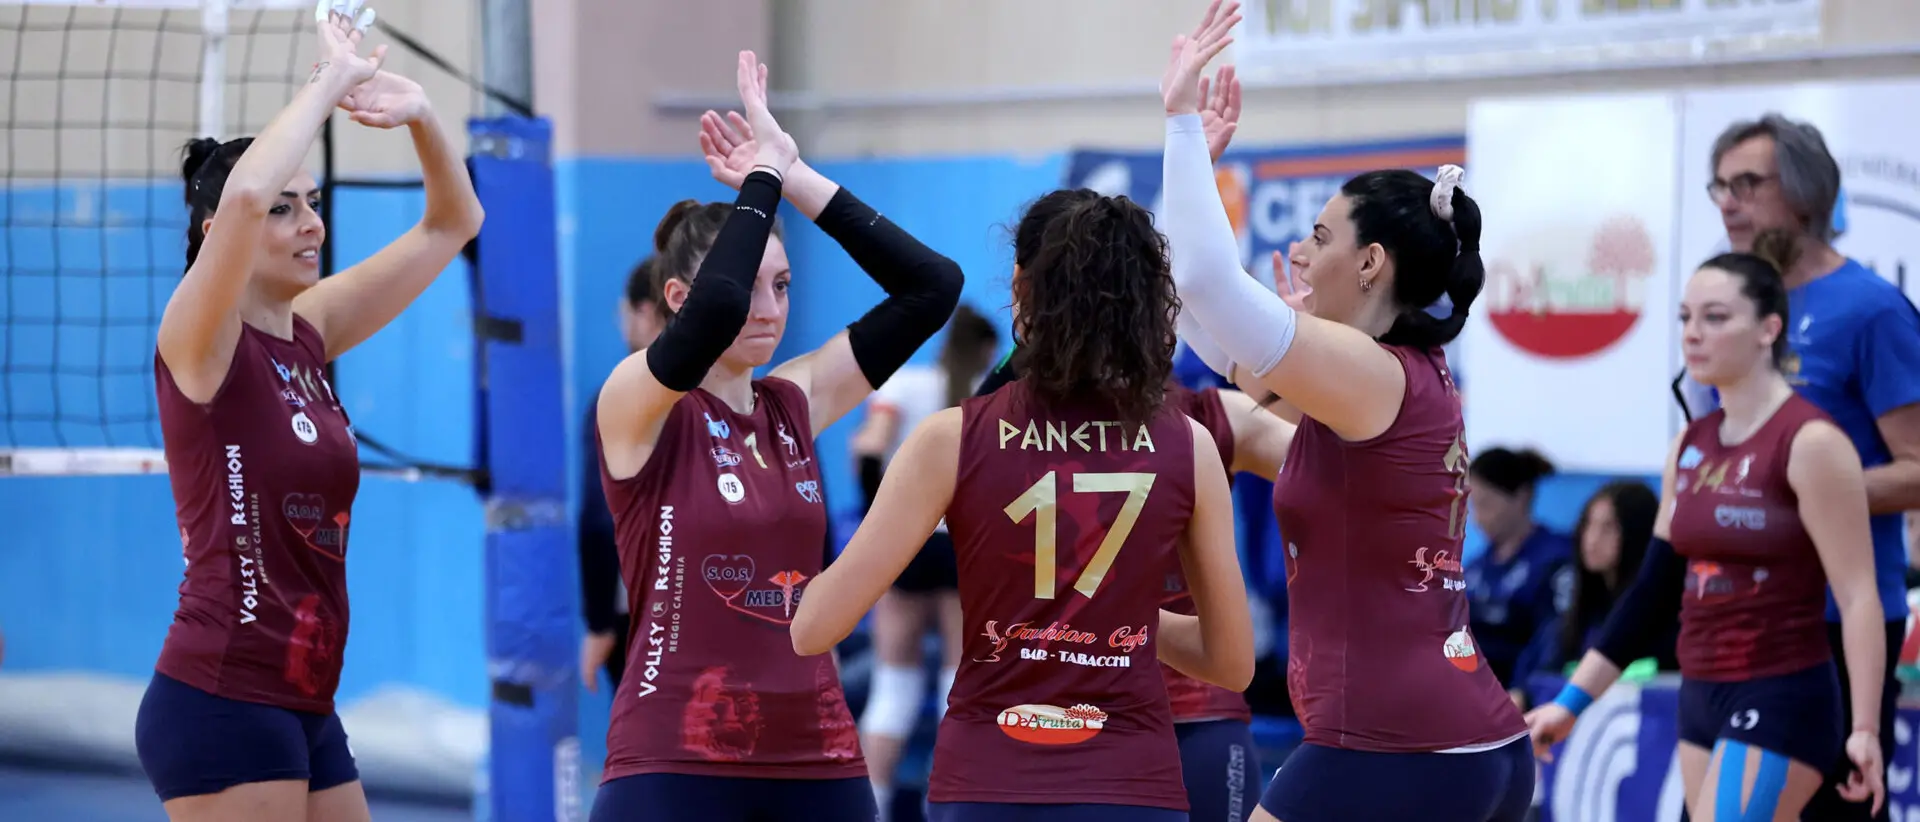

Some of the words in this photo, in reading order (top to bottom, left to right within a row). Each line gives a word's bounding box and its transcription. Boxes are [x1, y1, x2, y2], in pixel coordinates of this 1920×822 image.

[999, 418, 1156, 453] PANETTA
[225, 444, 248, 526] REGHION
[1003, 471, 1156, 599] 17
[239, 554, 259, 625] VOLLEY
[638, 621, 665, 698] VOLLEY
[654, 505, 675, 591] REGHION
[673, 556, 686, 610] CALABRIA
[668, 612, 682, 653] REGGIO
[1020, 647, 1048, 661] BAR
[1058, 650, 1130, 667] TABACCHI
